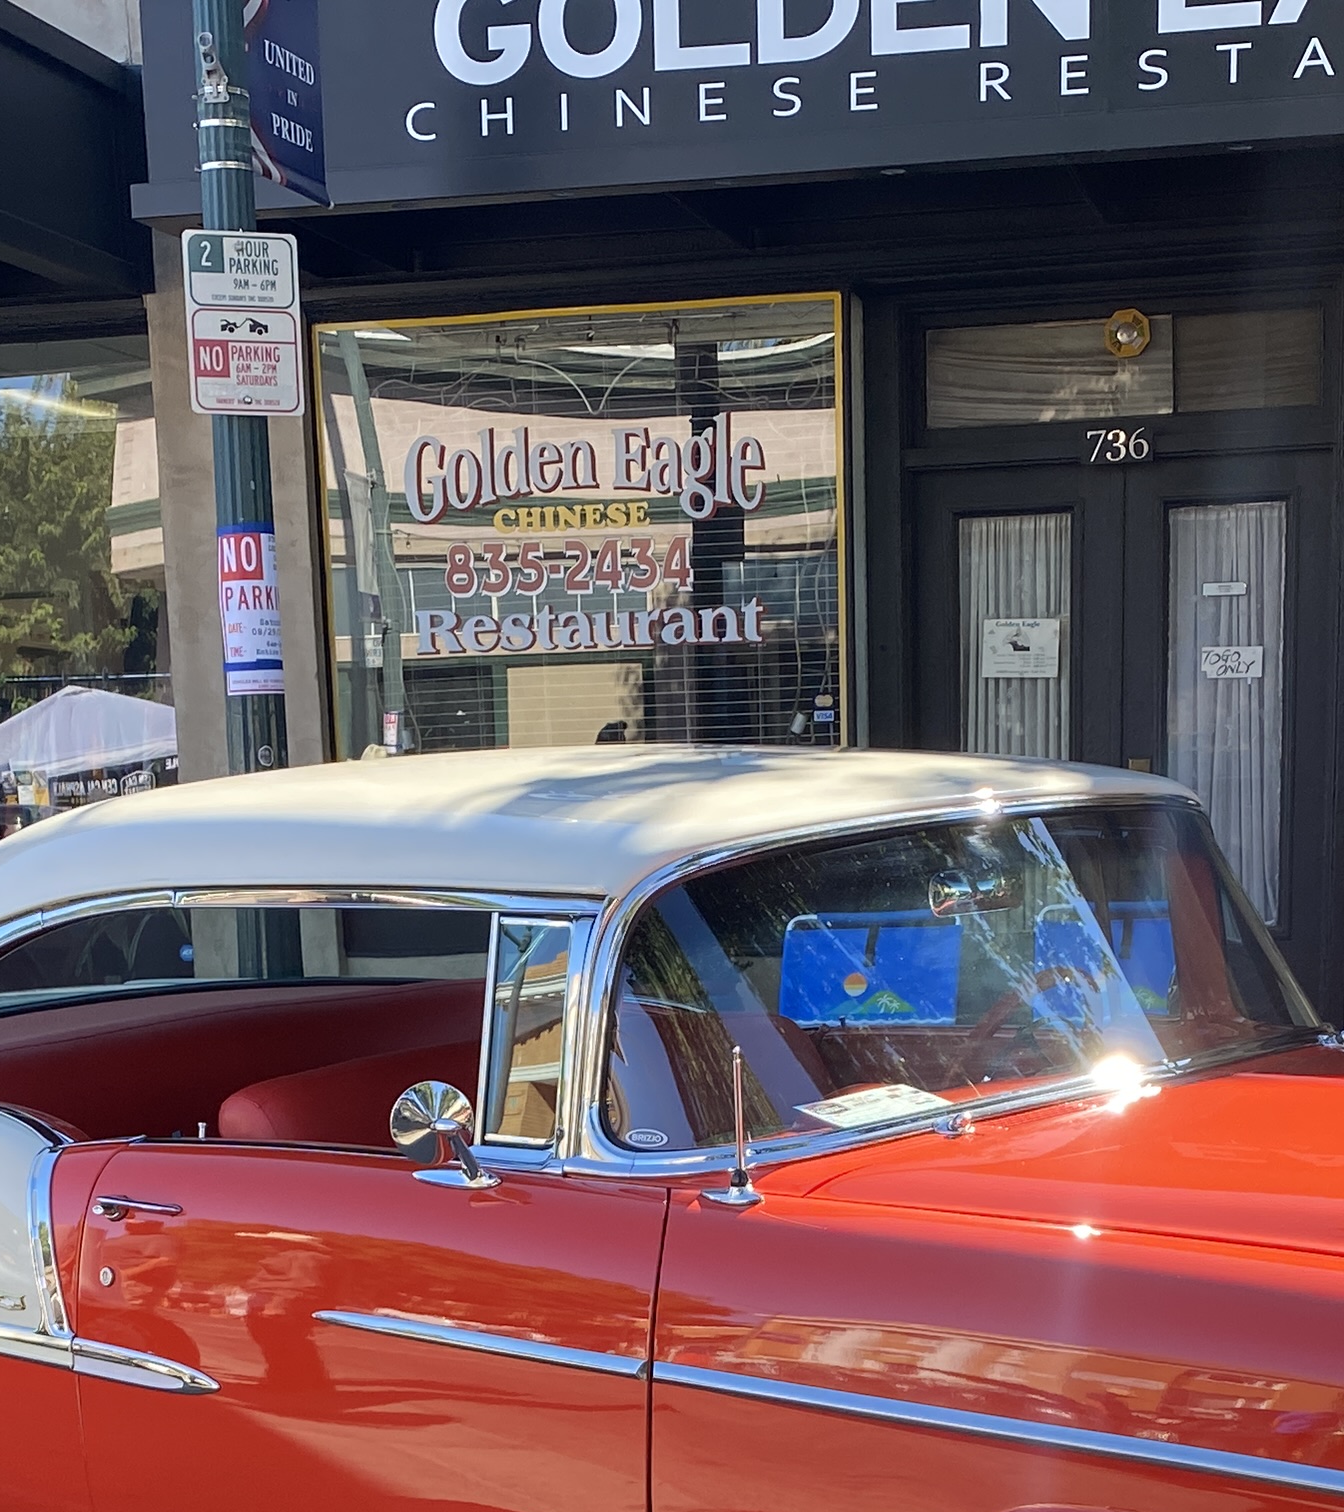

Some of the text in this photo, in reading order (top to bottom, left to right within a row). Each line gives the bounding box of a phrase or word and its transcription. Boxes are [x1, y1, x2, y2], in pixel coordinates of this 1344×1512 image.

[264, 39, 315, 86] UNITED
[287, 88, 298, 107] IN
[405, 71, 879, 142] CHINESE
[271, 112, 314, 153] PRIDE
[199, 240, 212, 267] 2
[235, 240, 269, 258] HOUR
[229, 258, 279, 276] PARKING
[233, 277, 249, 291] 9AM
[260, 279, 277, 291] 6PM
[199, 345, 224, 372] NO
[231, 345, 281, 363] PARKING
[236, 363, 252, 374] 6AM
[262, 364, 277, 375] 2PM
[236, 374, 278, 387] SATURDAYS
[1086, 427, 1150, 463] 736
[404, 411, 767, 525] Golden Eagle
[493, 501, 651, 534] CHINESE
[222, 536, 257, 574] NO
[445, 534, 695, 598] 835-2434
[226, 586, 280, 611] PARKI
[415, 597, 765, 656] Restaurant
[1216, 660, 1256, 677] ONLY
[816, 712, 833, 720] VISA
[631, 1133, 662, 1143] BRIZIO
